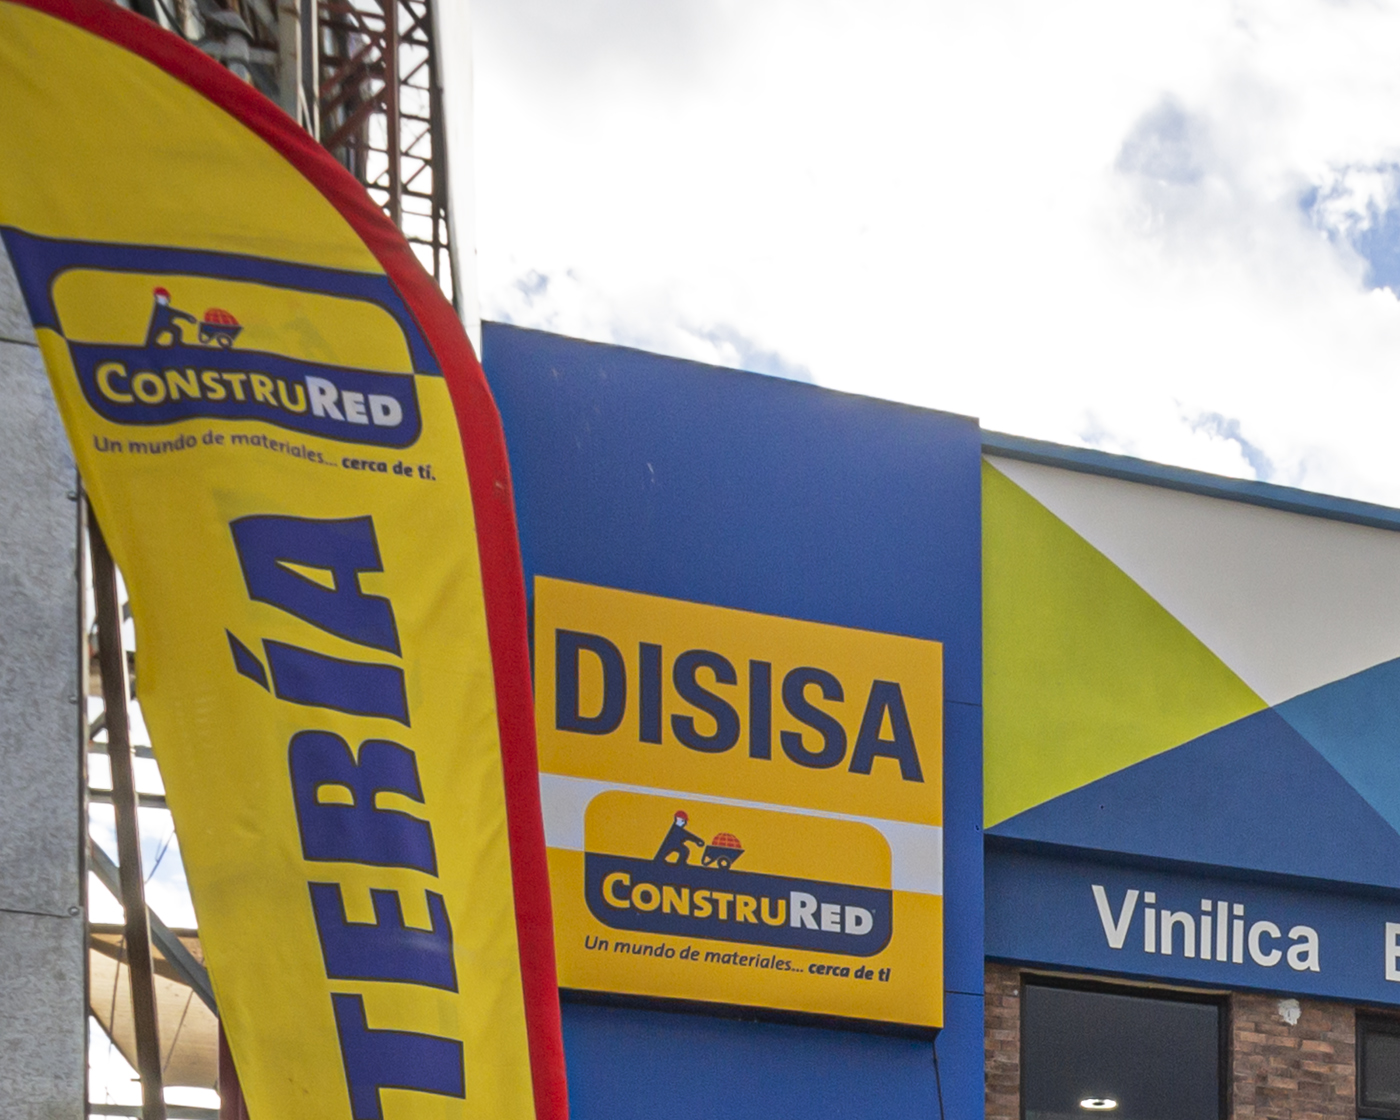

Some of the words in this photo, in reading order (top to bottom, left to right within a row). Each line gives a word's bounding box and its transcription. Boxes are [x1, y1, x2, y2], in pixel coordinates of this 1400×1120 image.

[93, 435, 122, 453] Un
[128, 434, 197, 455] mundo
[202, 430, 225, 446] de
[231, 434, 338, 467] materiales...
[342, 456, 387, 474] cerca
[393, 460, 413, 477] de
[555, 628, 925, 783] DISISA
[584, 935, 609, 951] Un
[613, 941, 676, 959] mundo
[679, 945, 700, 961] de
[704, 950, 804, 973] materiales...
[807, 961, 850, 978] cerca
[854, 965, 874, 980] de
[1091, 884, 1321, 972] Vinilica
